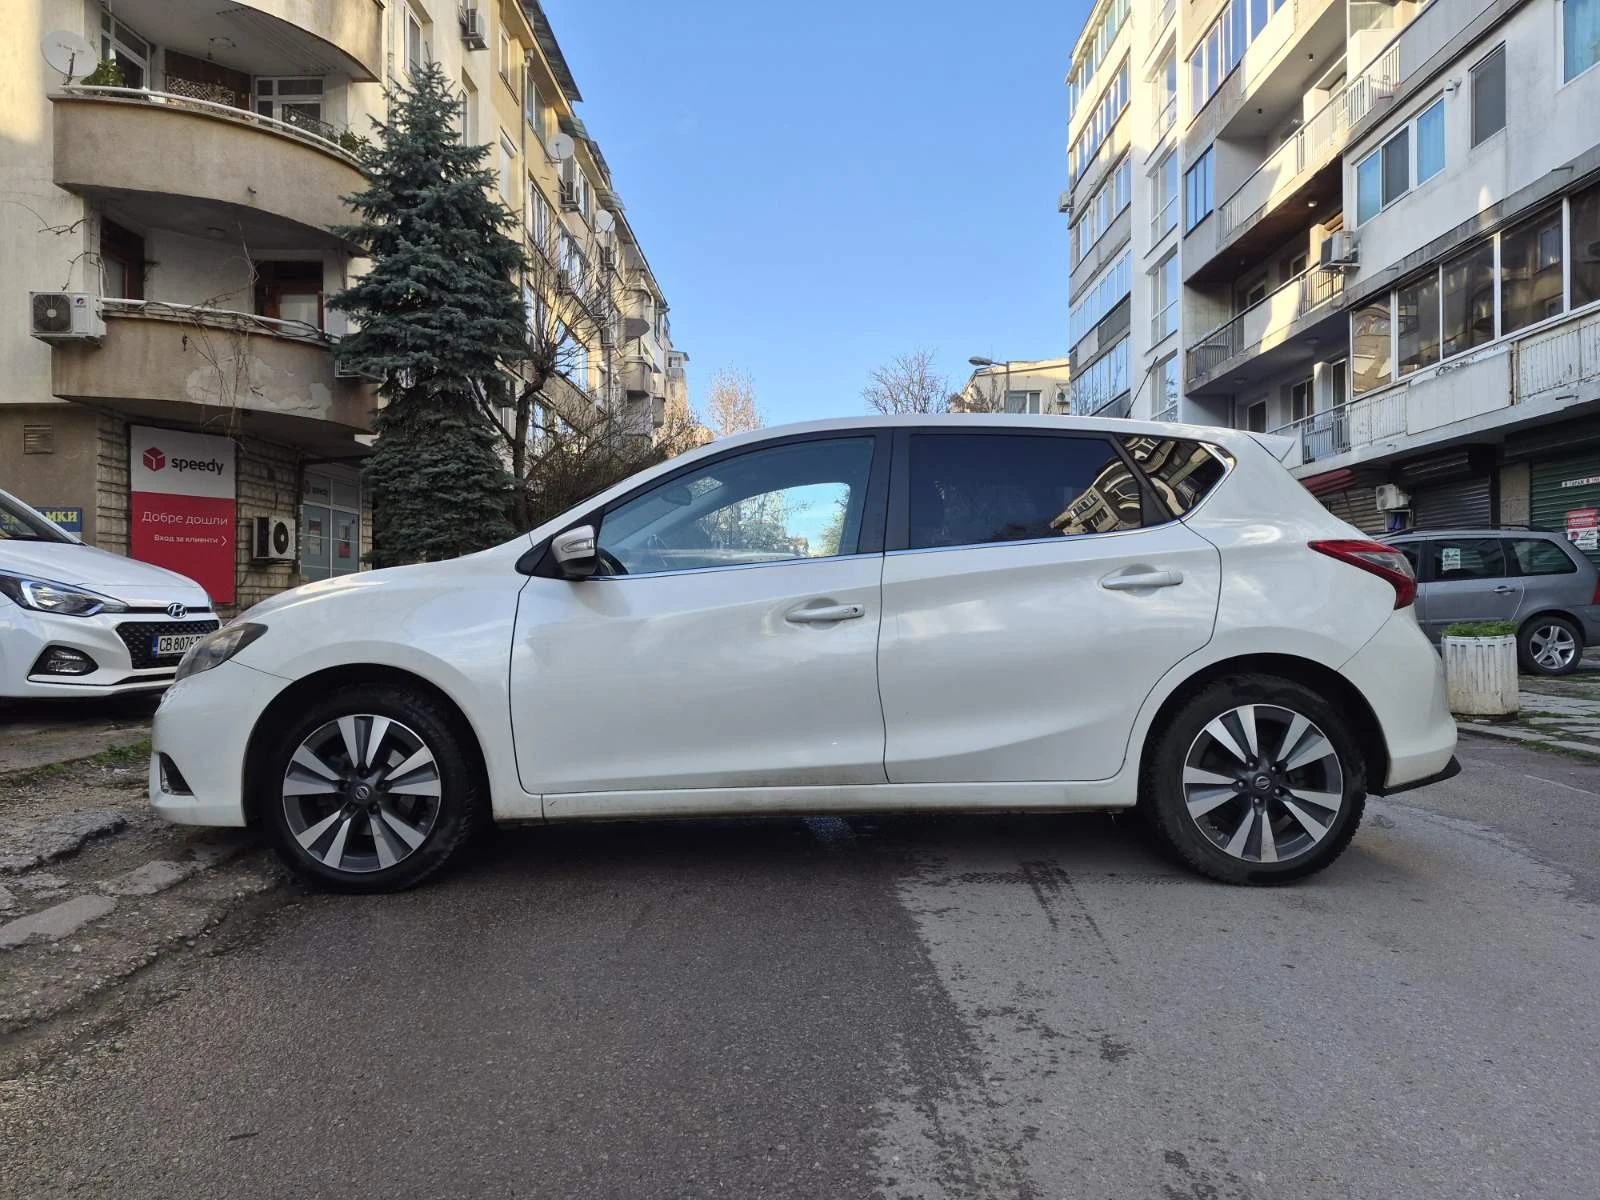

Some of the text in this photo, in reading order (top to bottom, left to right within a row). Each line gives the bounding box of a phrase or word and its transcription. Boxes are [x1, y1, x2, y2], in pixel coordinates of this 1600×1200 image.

[171, 457, 224, 475] speedy
[44, 511, 78, 522] МКИ
[142, 511, 228, 525] Добре дошли
[154, 534, 174, 542] Вход
[160, 638, 173, 652] CB
